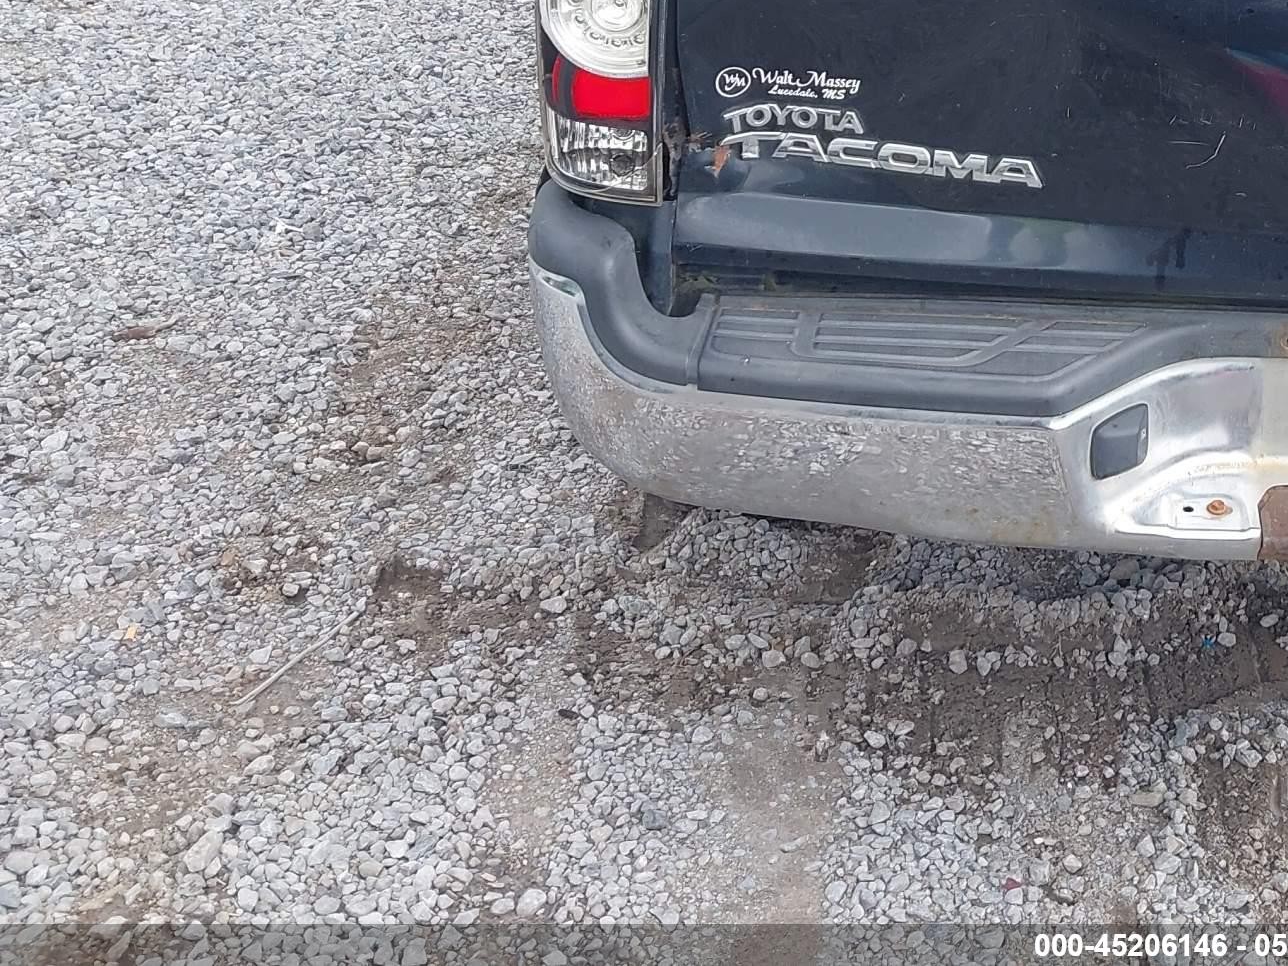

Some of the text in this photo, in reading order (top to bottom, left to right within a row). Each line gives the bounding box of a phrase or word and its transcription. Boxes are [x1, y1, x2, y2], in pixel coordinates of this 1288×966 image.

[752, 67, 861, 94] Walt Massey
[821, 88, 847, 100] MS
[723, 103, 864, 134] TOYOTA
[720, 131, 1043, 189] TACOMA
